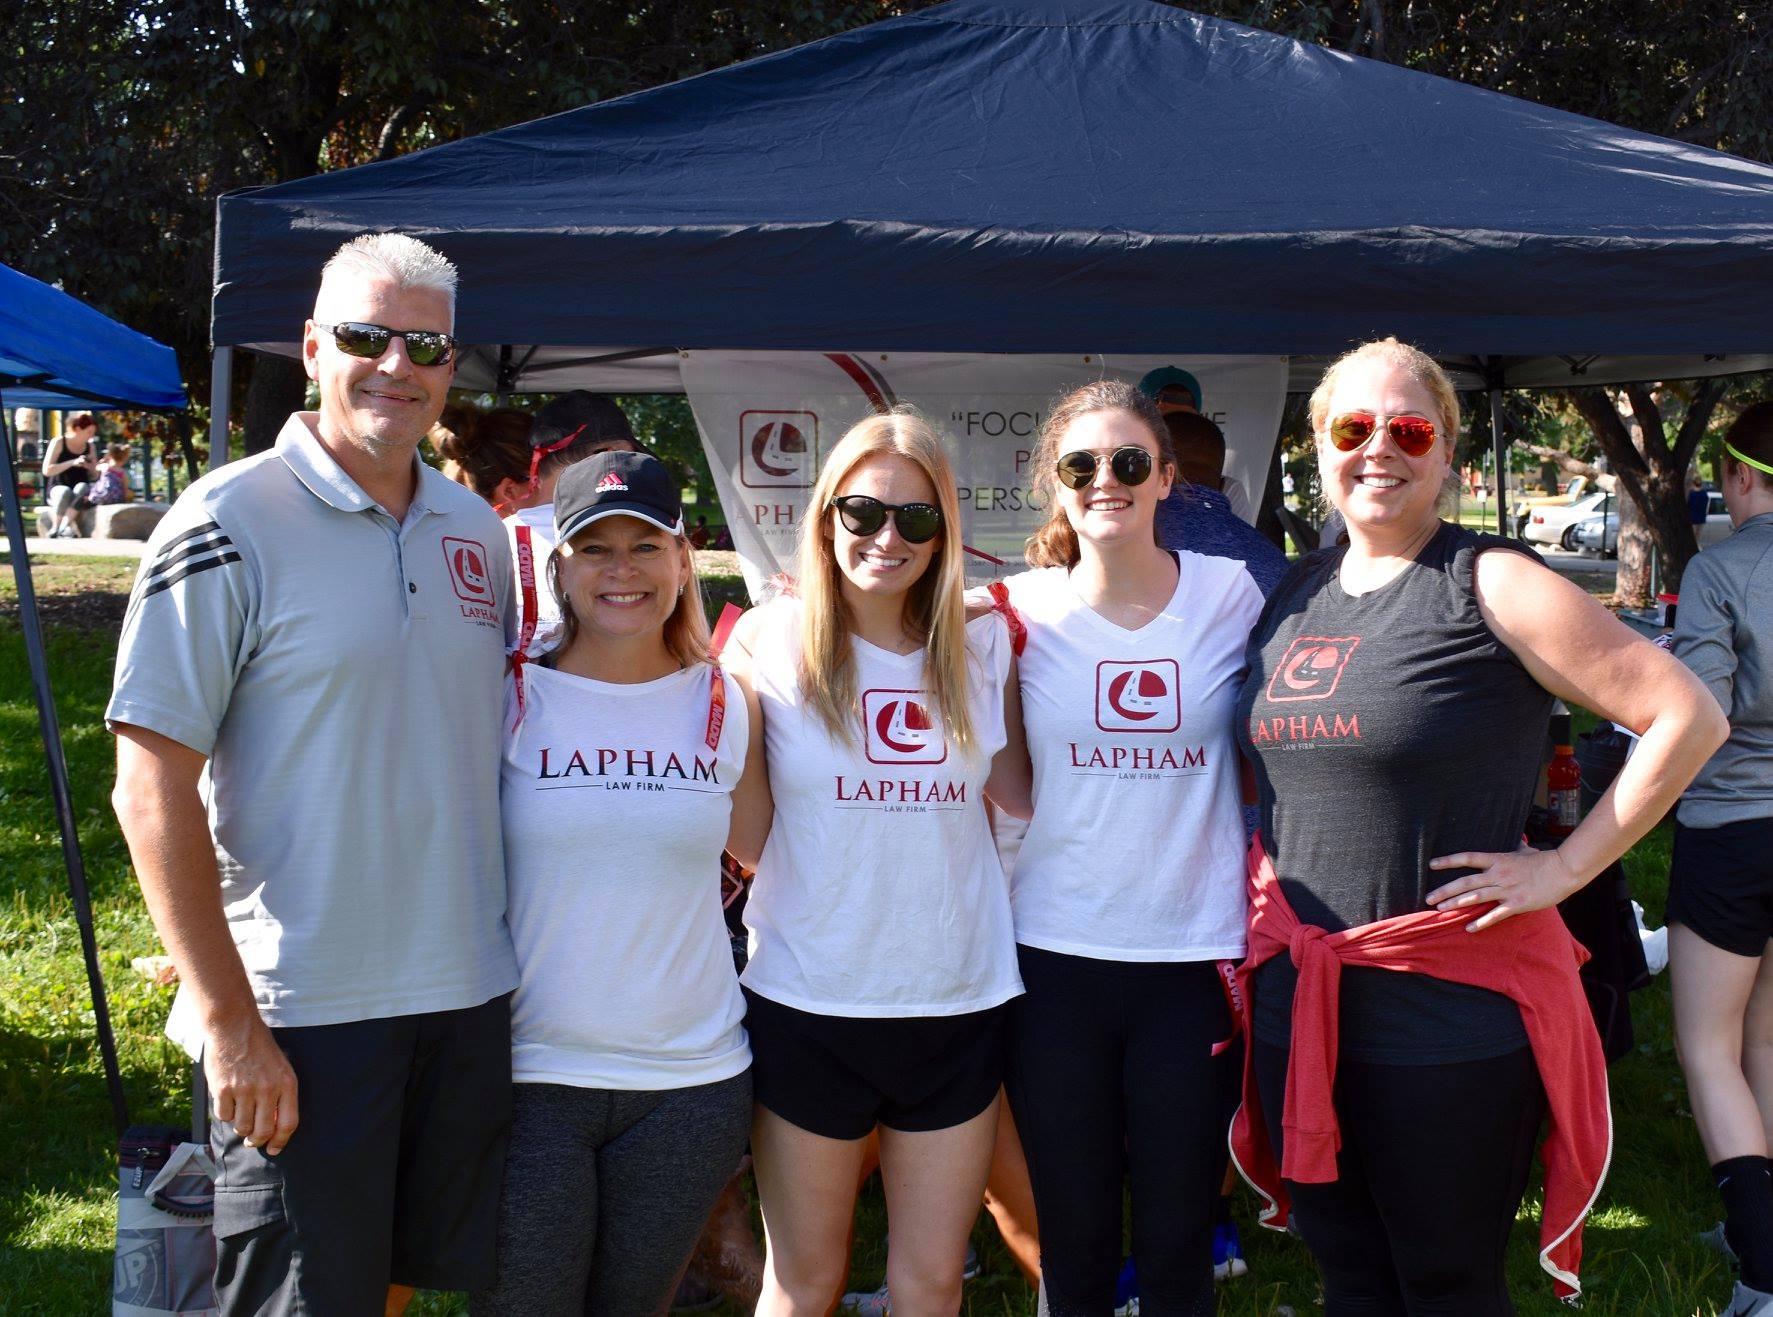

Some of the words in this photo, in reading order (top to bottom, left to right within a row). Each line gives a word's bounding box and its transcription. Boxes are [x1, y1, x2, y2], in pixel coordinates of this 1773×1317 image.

[595, 484, 629, 494] adidas
[957, 487, 1050, 511] PERSO
[518, 543, 535, 588] MADD
[707, 703, 724, 748] MADD
[1068, 742, 1207, 769] LAPHAM
[1281, 743, 1296, 751] LAW
[1298, 742, 1315, 750] FIRM
[537, 747, 720, 785] LAPHAM
[1118, 772, 1137, 780] LAW
[1139, 772, 1161, 780] FIRM
[606, 781, 631, 790] LAW
[636, 782, 665, 792] FIRM
[835, 775, 966, 802] LAPHAM
[884, 805, 903, 813] LAW
[906, 805, 927, 813] FIRM
